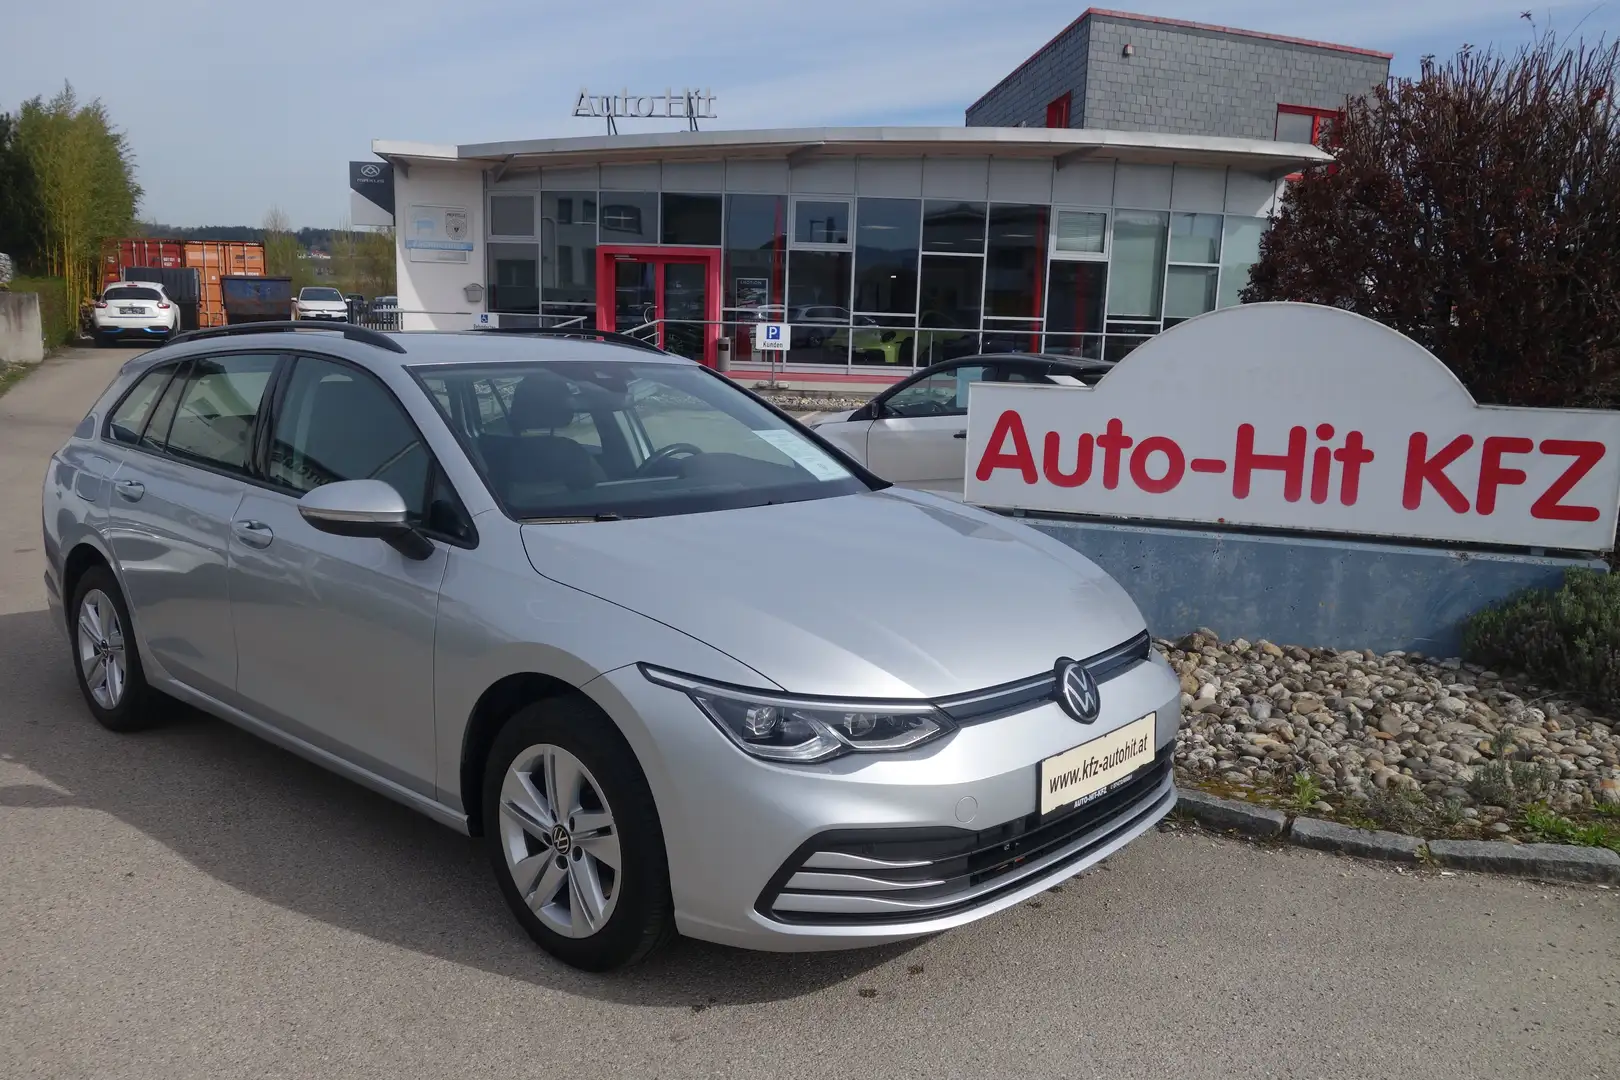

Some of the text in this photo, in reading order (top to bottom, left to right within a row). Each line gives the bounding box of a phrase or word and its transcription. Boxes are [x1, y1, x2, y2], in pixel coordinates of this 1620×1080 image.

[572, 86, 717, 118] Auto Hit
[975, 409, 1607, 522] Auto-Hit KFZ
[1049, 733, 1148, 794] www.kfz-autohit.at
